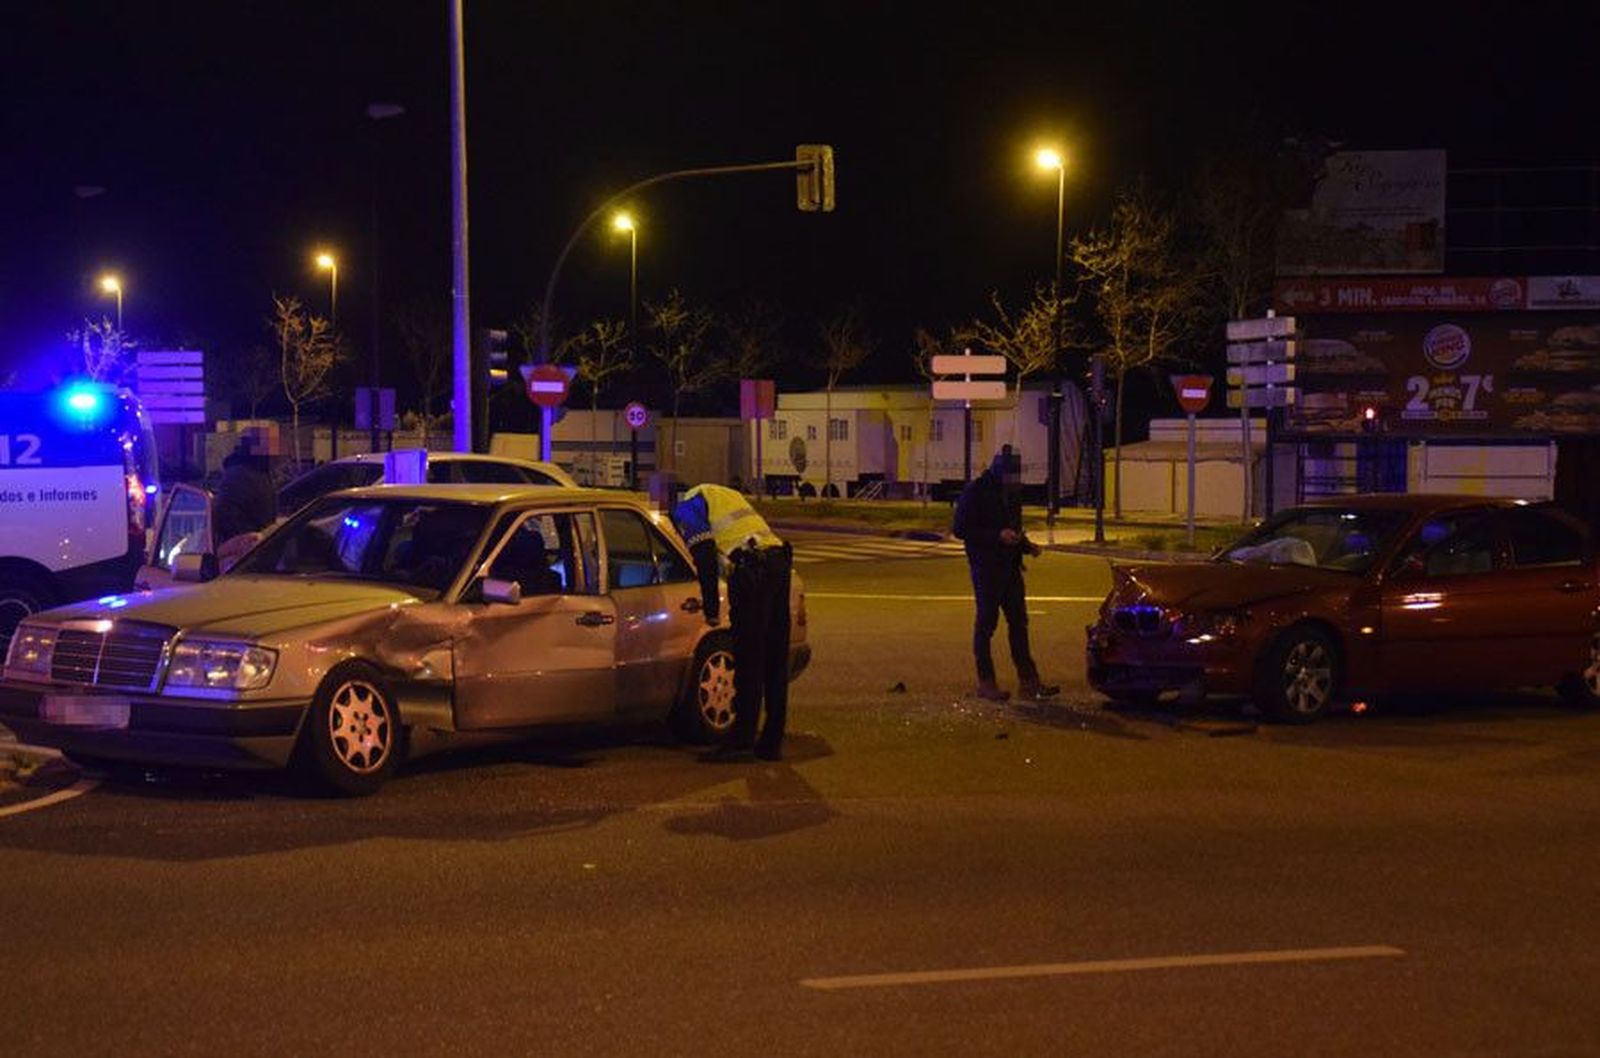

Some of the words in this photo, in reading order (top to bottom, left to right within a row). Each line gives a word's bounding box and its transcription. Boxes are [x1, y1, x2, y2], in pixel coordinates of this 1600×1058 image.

[1319, 287, 1331, 306] 3
[1406, 374, 1430, 410] 2
[27, 491, 36, 502] e
[40, 488, 98, 501] Informes
